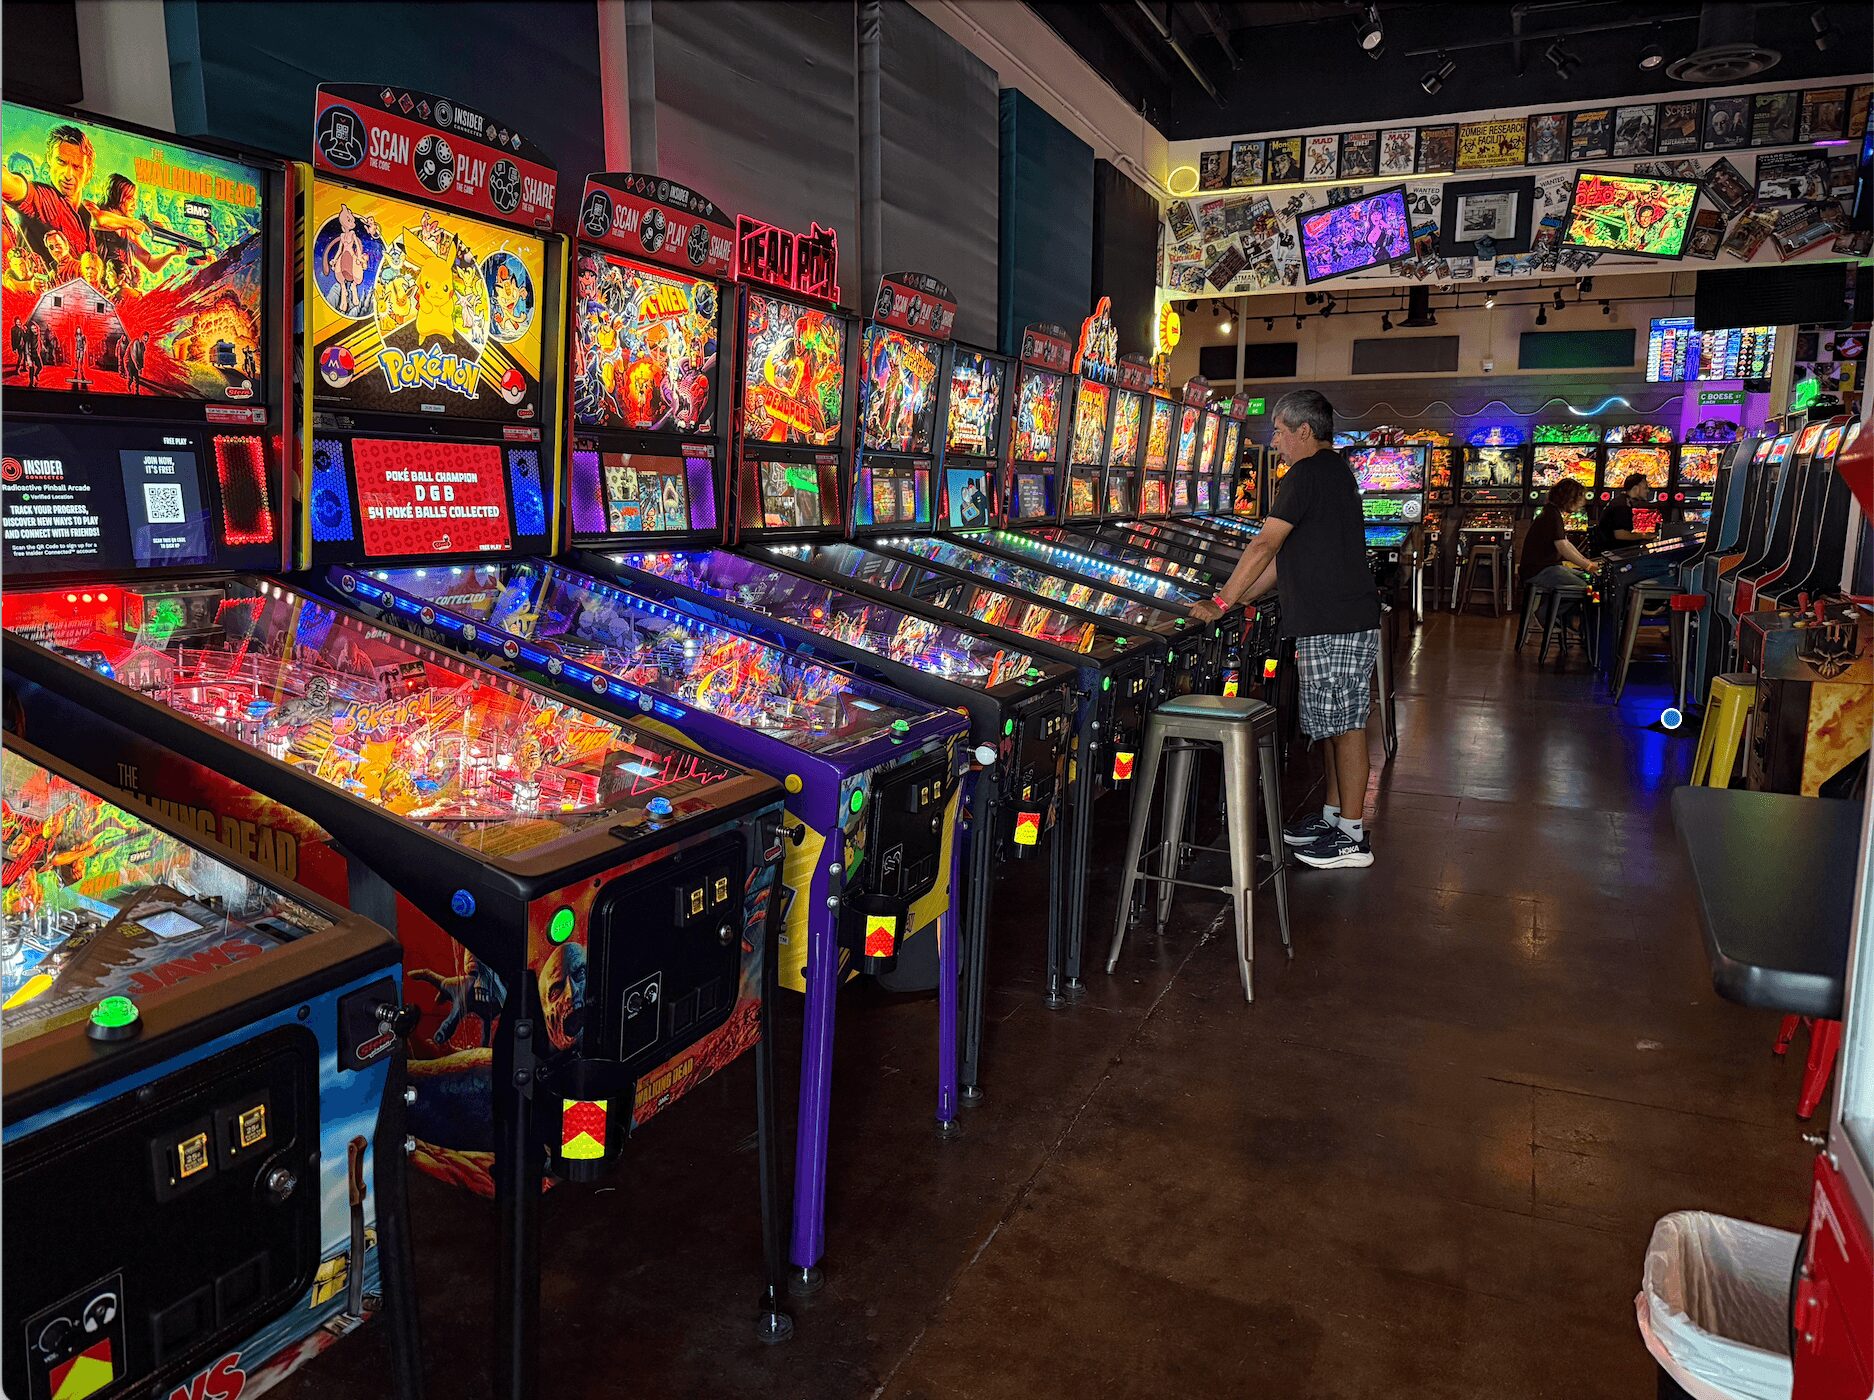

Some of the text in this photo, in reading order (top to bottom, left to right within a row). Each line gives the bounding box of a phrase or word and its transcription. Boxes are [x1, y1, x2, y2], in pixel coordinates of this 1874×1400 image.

[453, 107, 484, 132] INSIDER
[453, 124, 483, 138] CONNECTED
[1387, 133, 1410, 141] MAD
[1461, 126, 1488, 137] ZOMBIE
[1489, 123, 1526, 135] RESEARCH
[1312, 137, 1333, 145] MAD
[1478, 134, 1507, 145] FACILITY
[1240, 144, 1259, 152] MAD
[369, 127, 556, 211] SCAN PLAY SHARE
[134, 156, 257, 208] WALKING DEAD
[1539, 176, 1566, 187] WANTED
[669, 185, 690, 204] INSIDER
[185, 203, 210, 218] amc
[613, 204, 733, 261] SCAN PLAY SHARE
[163, 437, 187, 445] FREE PLAY
[23, 459, 64, 476] INSIDER
[144, 456, 175, 467] JOIN NOW,
[145, 465, 175, 474] IT'S FREE!
[385, 467, 478, 483] POKÉ BALL CHAMPION
[2, 484, 91, 492] Radioactive Pinball Arcade
[415, 485, 455, 501] D G B
[10, 505, 89, 516] TRACK YOUR PROGRESS,
[368, 502, 500, 519] 54 POKÉ BALLS COLLECTED
[2, 516, 99, 527] DISCOVER NEW WAYS TO PLAY
[4, 527, 100, 540] AND CONNECT WITH FRIENDS!
[117, 763, 138, 790] THE
[221, 814, 297, 881] DEAD
[1338, 845, 1360, 856] HOKA
[127, 939, 264, 994] JAWS
[635, 1057, 694, 1108] WALKING DEAD
